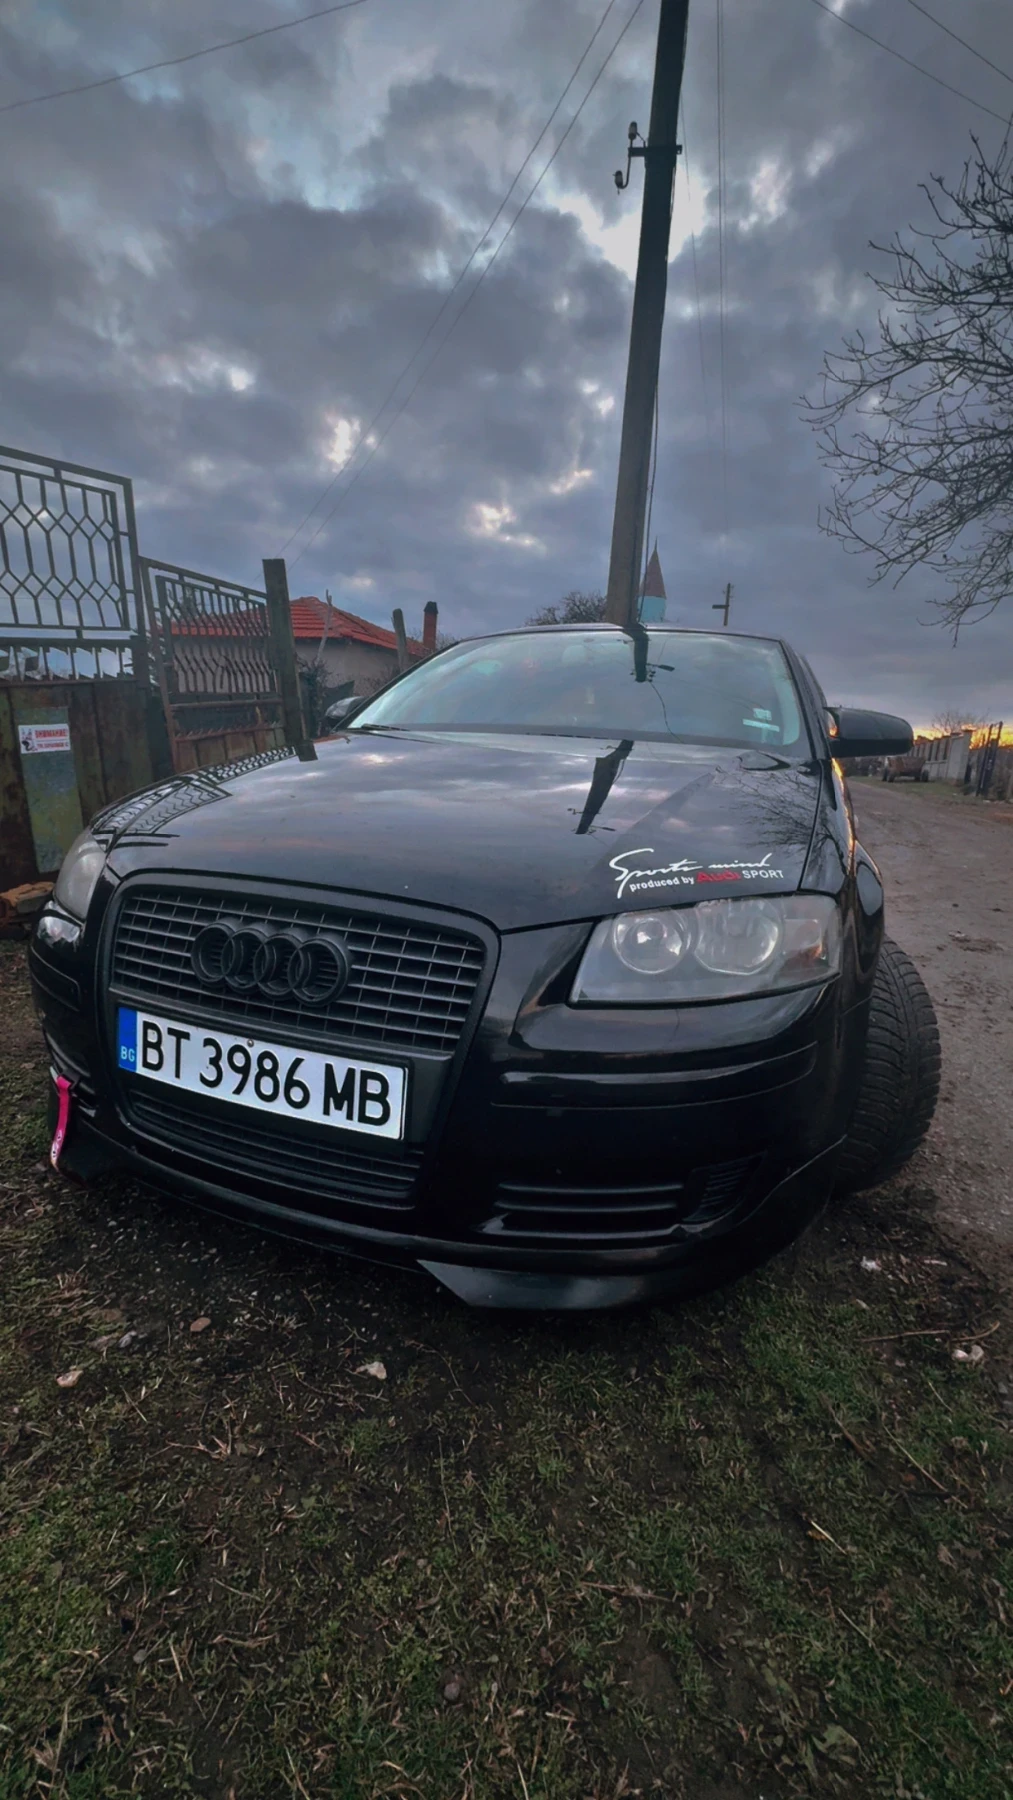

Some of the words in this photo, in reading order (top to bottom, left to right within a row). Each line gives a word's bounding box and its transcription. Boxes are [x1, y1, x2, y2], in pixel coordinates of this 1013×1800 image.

[629, 877, 680, 892] produced
[681, 876, 695, 885] by
[742, 869, 784, 879] SPORT
[120, 1046, 135, 1062] BG
[141, 1020, 191, 1079] BT
[199, 1037, 311, 1110] 3986
[322, 1062, 391, 1127] MB
